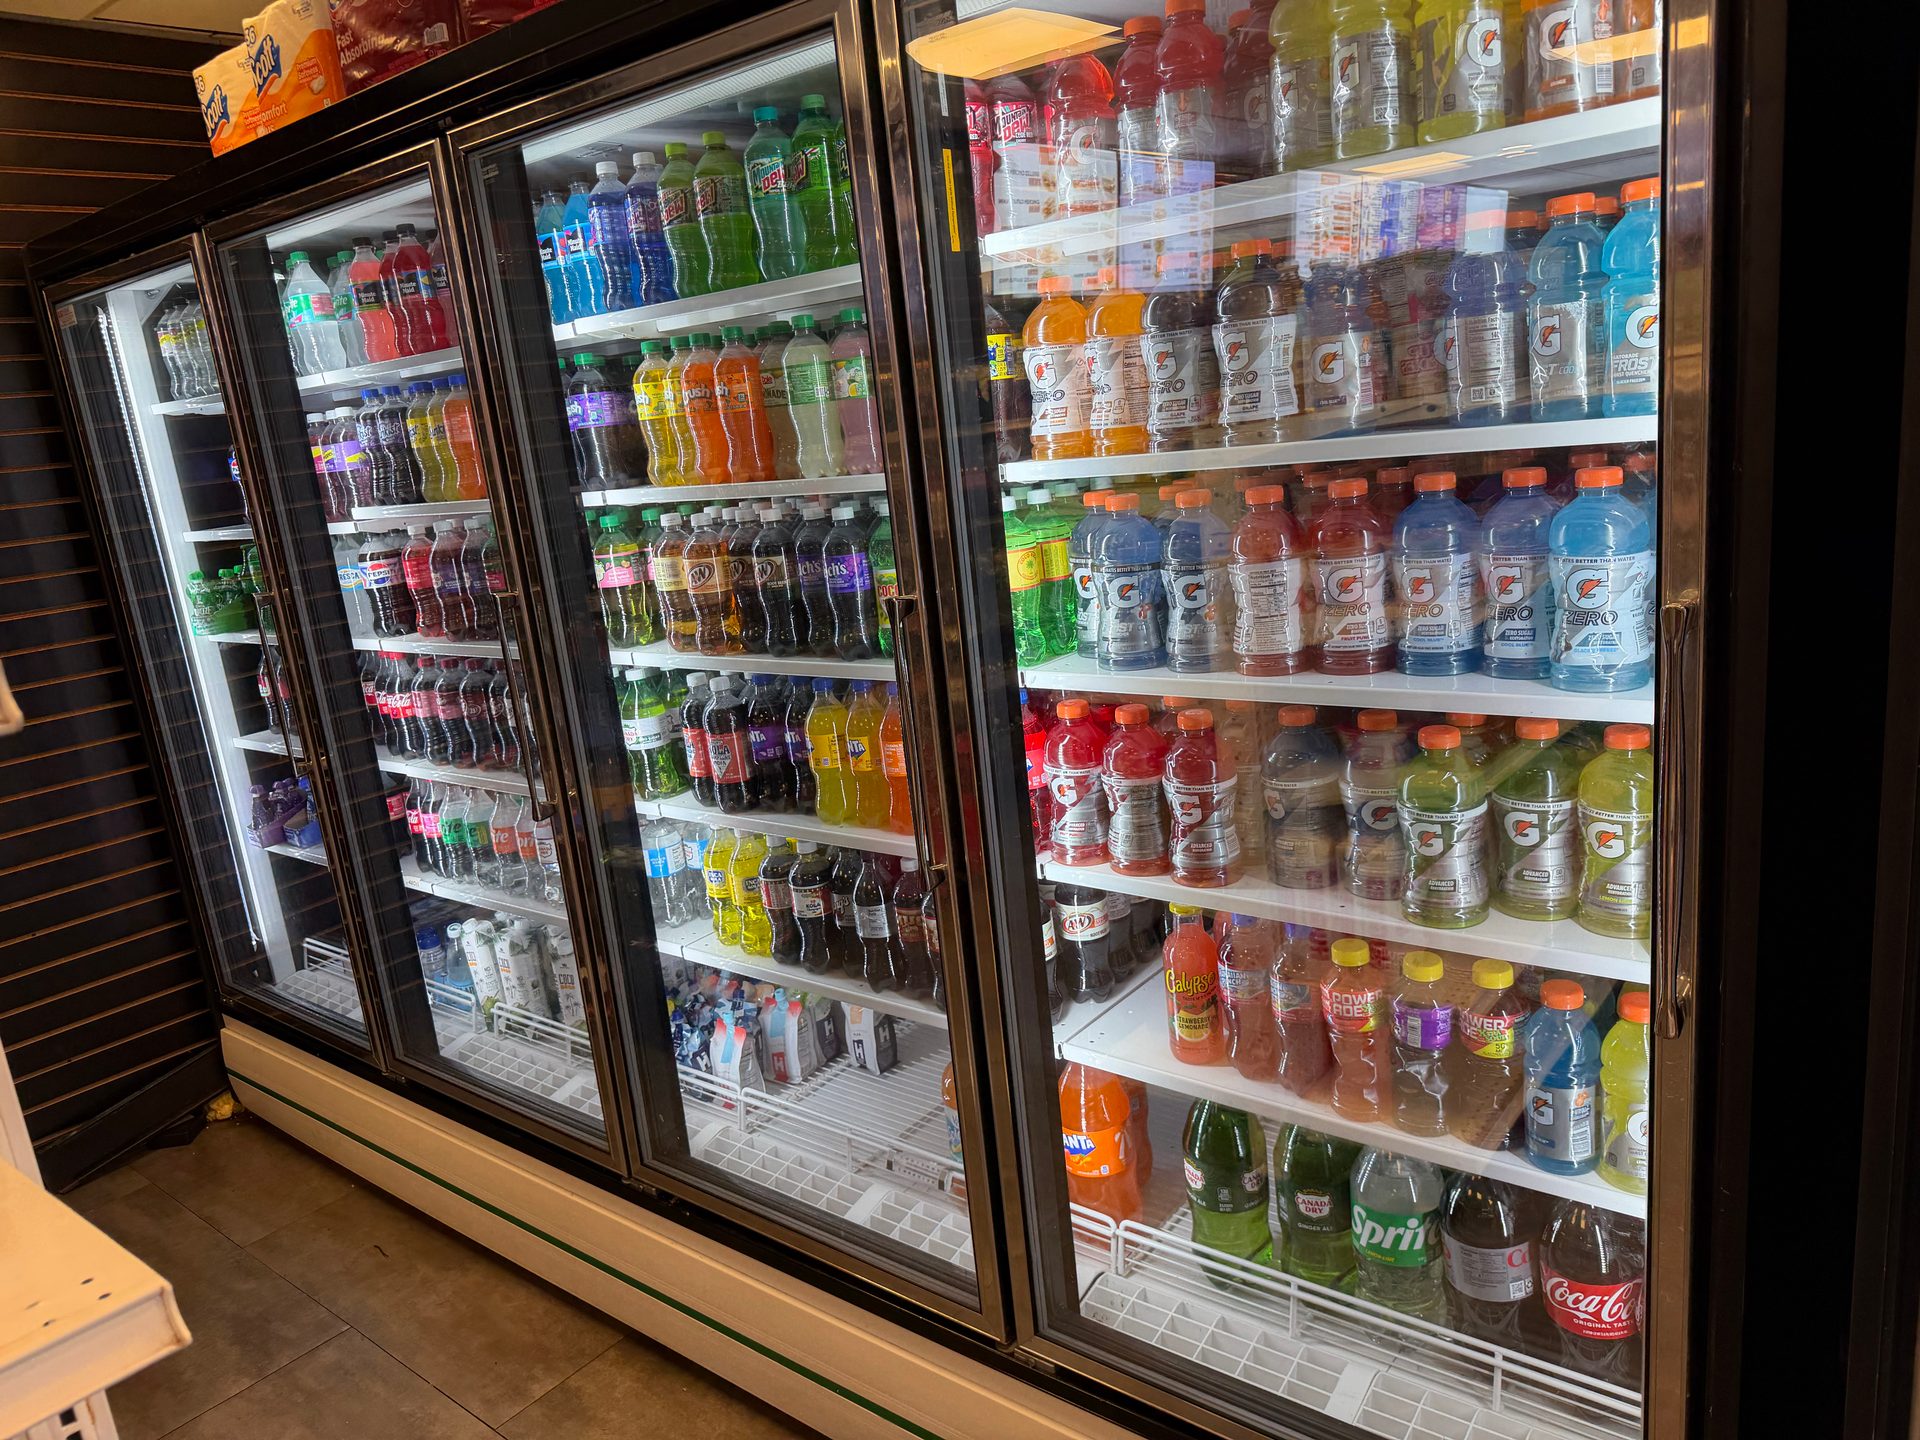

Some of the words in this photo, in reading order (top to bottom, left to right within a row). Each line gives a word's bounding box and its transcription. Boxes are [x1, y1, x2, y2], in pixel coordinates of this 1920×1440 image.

[336, 28, 353, 50] Fast
[340, 33, 385, 67] Absorbing
[201, 84, 224, 137] Scott
[260, 102, 288, 123] omfort
[1532, 314, 1561, 356] G
[1625, 304, 1658, 349] G
[1311, 341, 1344, 384] G
[367, 569, 391, 578] PEPSI
[1327, 566, 1365, 604] G
[1401, 567, 1435, 603] G
[1488, 566, 1525, 604] G
[1108, 574, 1140, 609] G
[1174, 575, 1207, 609] G
[1566, 568, 1610, 610] G
[1324, 601, 1372, 617] ZERO
[1400, 603, 1443, 618] ZERO
[1487, 605, 1534, 621] ZERO
[1566, 611, 1619, 626] ZERO
[1051, 778, 1077, 805] G
[1361, 800, 1400, 831] G
[1595, 810, 1614, 818] BETTER
[1412, 823, 1443, 856] G
[1504, 811, 1540, 846] G
[1587, 821, 1625, 858] G
[1428, 880, 1455, 888] ADVANCED
[1165, 969, 1216, 995] Calypso
[1332, 989, 1383, 1004] POWER
[1333, 1004, 1361, 1017] ADE
[1526, 1087, 1554, 1126] G
[1295, 1196, 1333, 1208] CANADA
[1304, 1206, 1324, 1214] DRY
[1298, 1222, 1321, 1231] GINGER
[1365, 1249, 1395, 1263] LEMON-LIME
[1573, 1318, 1612, 1329] ORIGINAL
